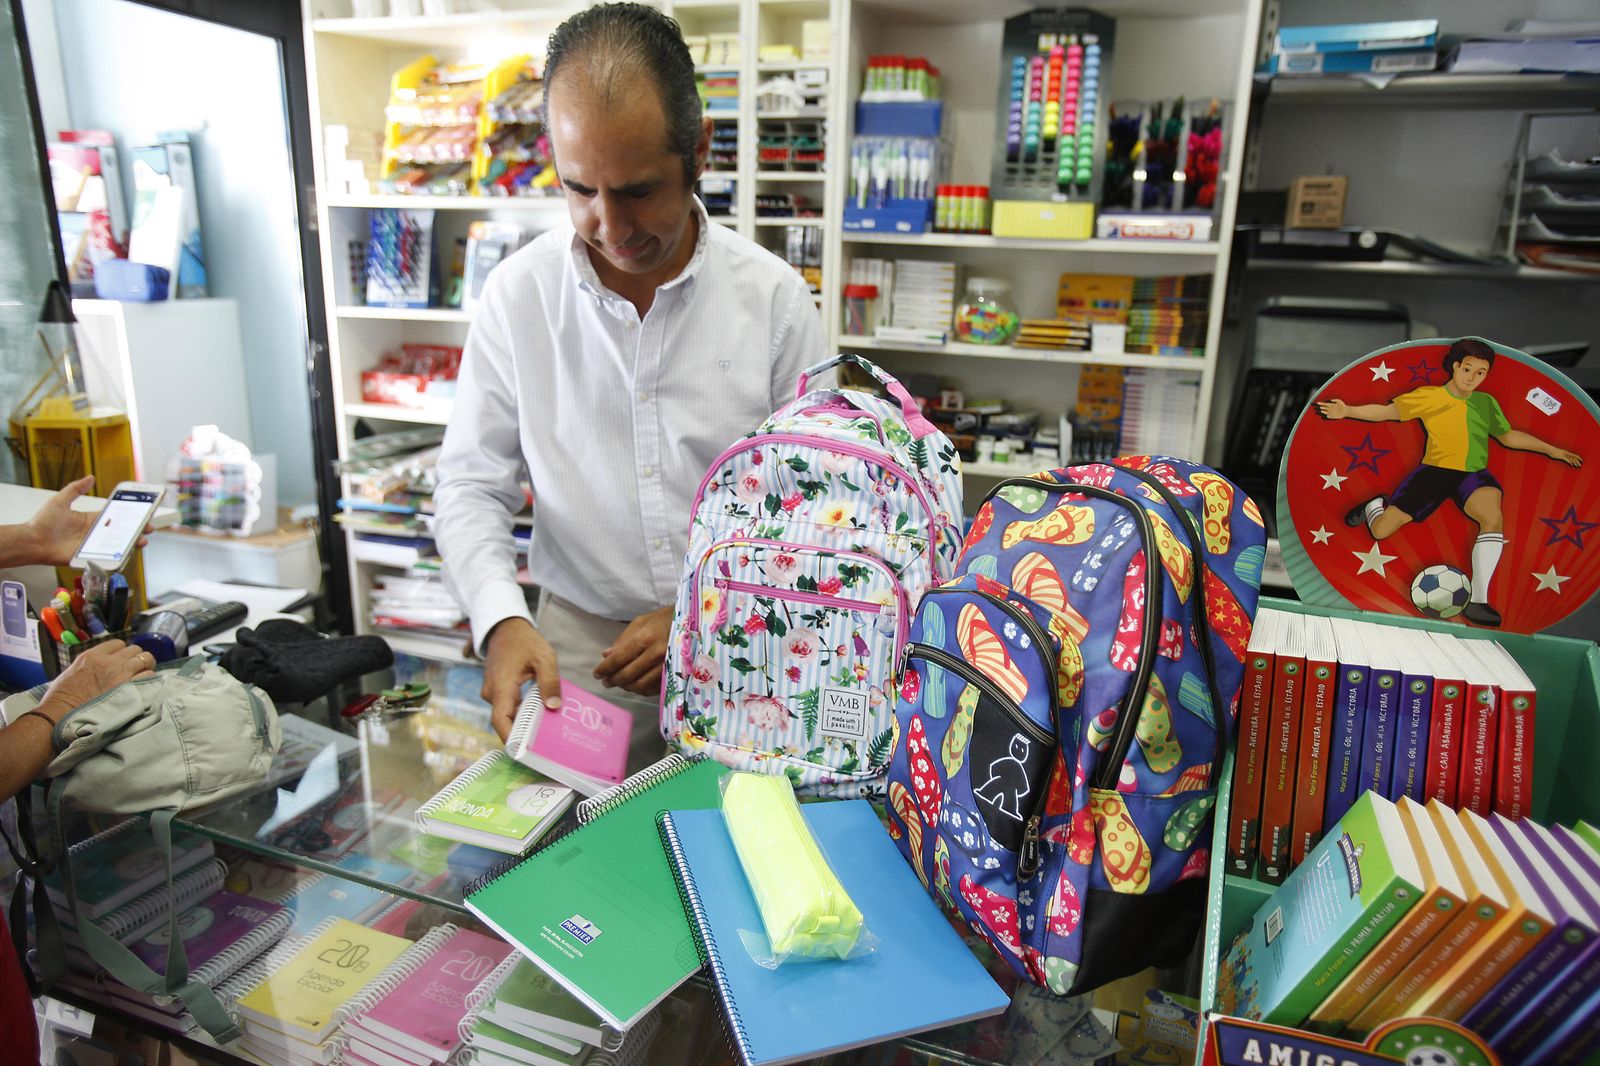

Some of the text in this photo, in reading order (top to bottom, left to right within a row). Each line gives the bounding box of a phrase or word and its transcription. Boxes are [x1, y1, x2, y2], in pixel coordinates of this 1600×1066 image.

[830, 694, 860, 710] VMB
[1347, 687, 1357, 716] VICTORIA
[1378, 692, 1388, 721] VICTORIA
[1410, 698, 1421, 727] VICTORIA
[831, 722, 854, 730] passion
[1249, 715, 1258, 747] AVENTURA
[1440, 702, 1454, 748] ABANDONADA
[1279, 721, 1289, 752] AVENTURA
[1311, 726, 1321, 757] AVENTURA
[1343, 735, 1352, 747] GOL
[1374, 740, 1383, 752] GOL
[1407, 746, 1416, 758] GOL
[1439, 750, 1449, 768] CASA
[1473, 756, 1484, 775] CASA
[1512, 764, 1522, 782] CASA
[562, 921, 591, 943] PREMIER
[1351, 926, 1372, 948] PRIMER
[1370, 902, 1396, 928] PARTIDO
